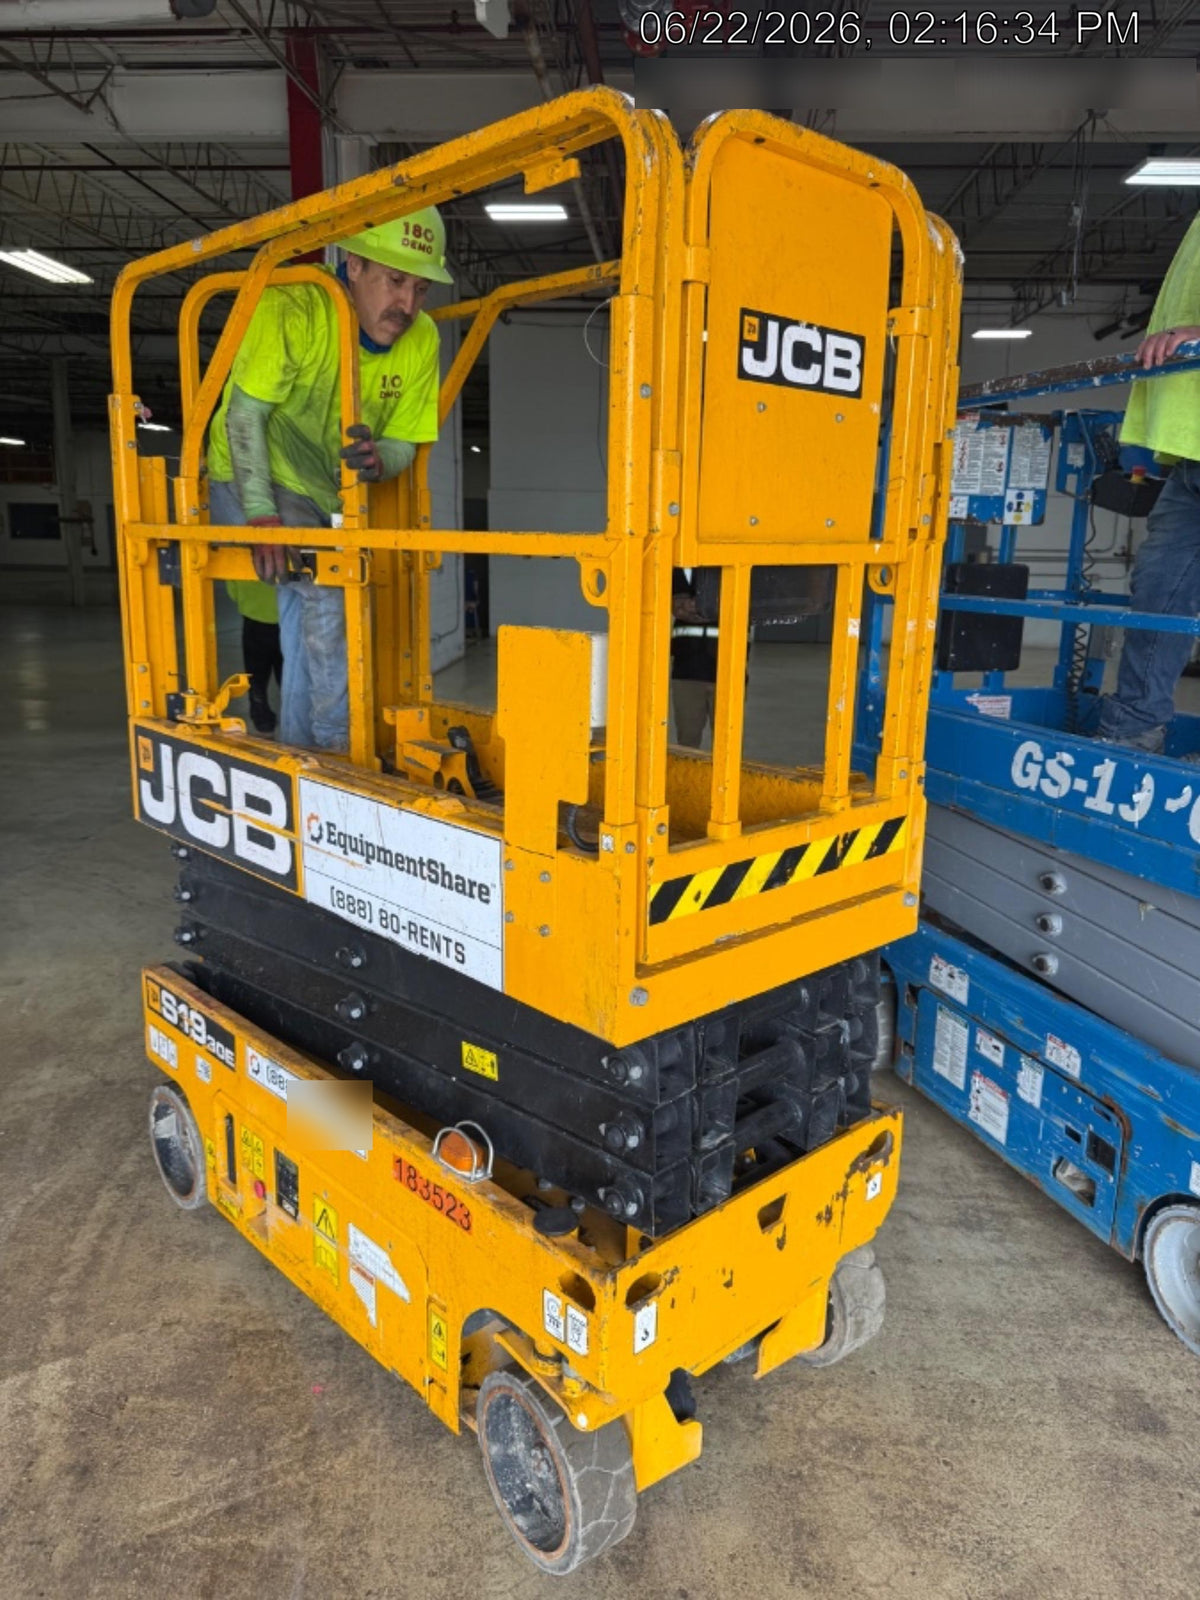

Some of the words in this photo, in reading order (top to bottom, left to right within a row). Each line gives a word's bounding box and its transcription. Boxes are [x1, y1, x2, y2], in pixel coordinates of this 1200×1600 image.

[402, 238, 433, 255] DEMO
[403, 221, 434, 243] 180
[381, 374, 402, 389] 10
[742, 319, 862, 392] JCB
[140, 742, 292, 875] JCB
[326, 821, 492, 905] EquipmentShare
[330, 885, 373, 924] (888)
[378, 907, 466, 965] 80-RENTS
[395, 1157, 472, 1231] 183523
